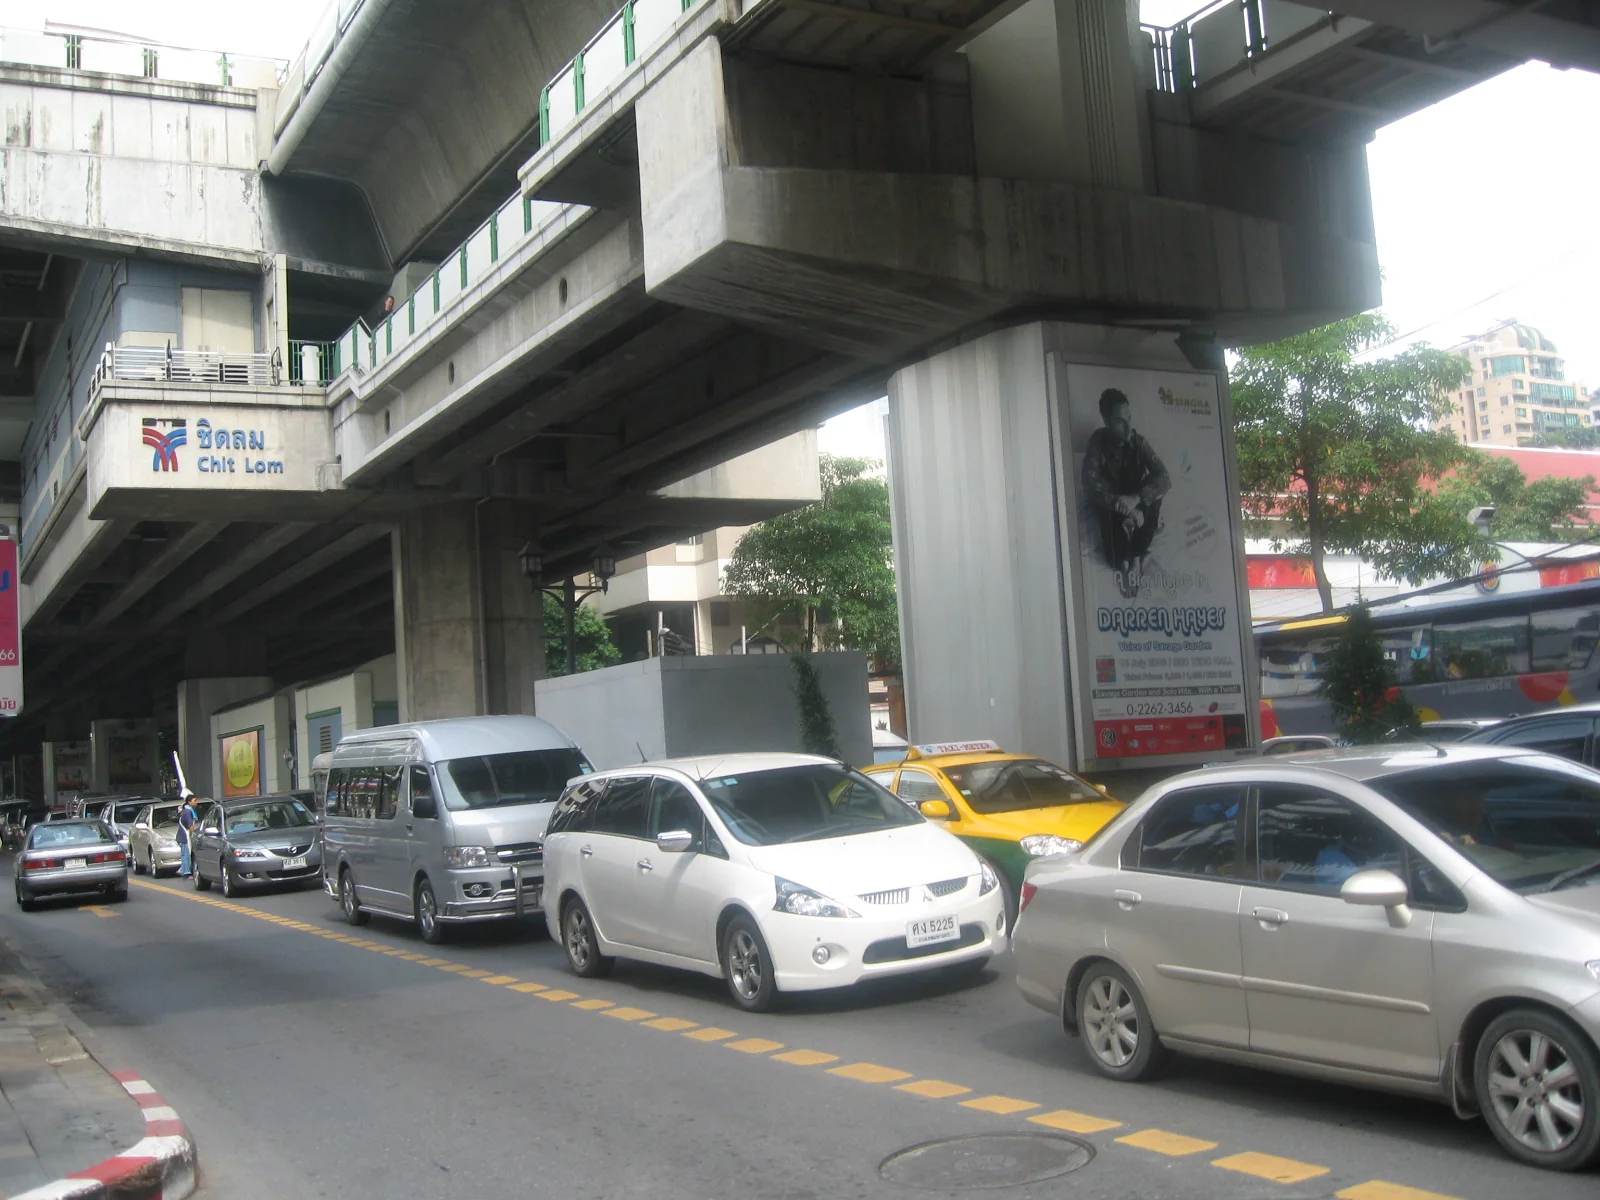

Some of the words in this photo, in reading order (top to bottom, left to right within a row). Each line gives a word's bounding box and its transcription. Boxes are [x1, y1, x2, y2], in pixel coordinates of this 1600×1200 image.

[142, 418, 187, 427] BTS
[196, 417, 265, 450] ชิดลม
[197, 456, 236, 473] Chit
[245, 457, 284, 474] Lom
[1097, 607, 1173, 637] DARREN
[1172, 607, 1226, 637] HAYES
[1118, 641, 1143, 652] Voice
[1143, 641, 1153, 652] of
[1121, 688, 1148, 698] Garden
[1148, 687, 1162, 697] and
[1126, 702, 1194, 716] 0-2262-3456
[936, 742, 993, 753] TAXI-METER
[929, 917, 954, 932] 5225
